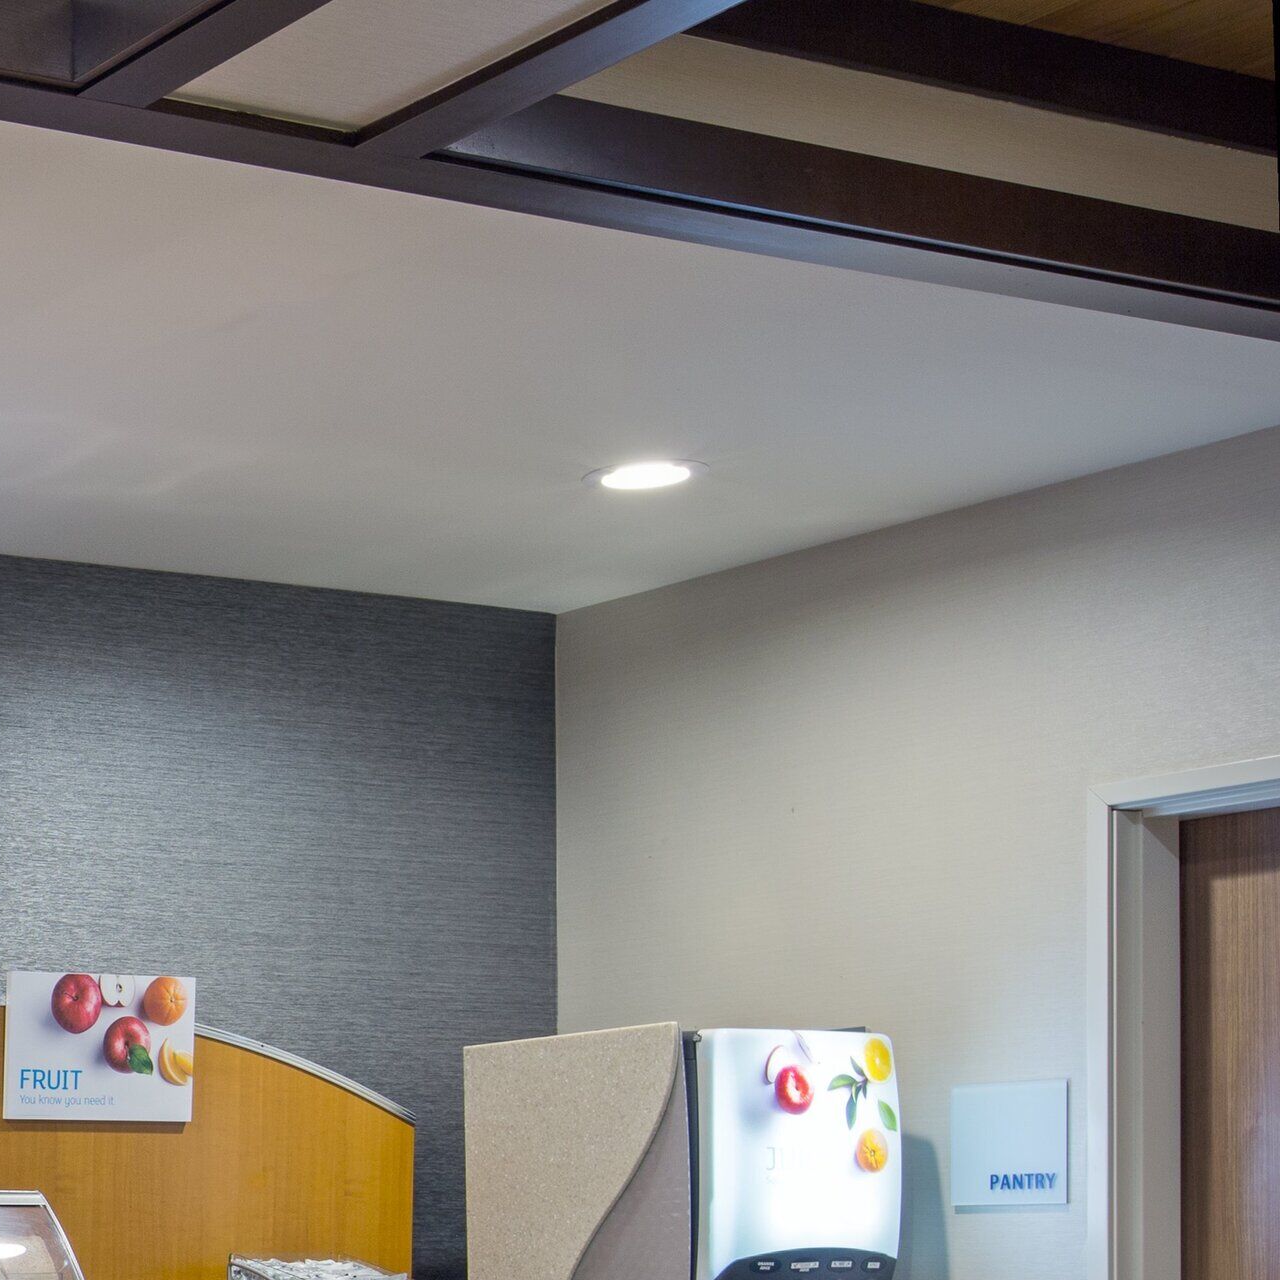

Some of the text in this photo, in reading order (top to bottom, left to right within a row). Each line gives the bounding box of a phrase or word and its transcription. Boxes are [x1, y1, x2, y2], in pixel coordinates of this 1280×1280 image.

[19, 1068, 83, 1091] FRUIT
[20, 1094, 36, 1105] You
[39, 1094, 62, 1105] know
[64, 1097, 82, 1108] you
[84, 1096, 106, 1106] need
[989, 1172, 1056, 1191] PANTRY
